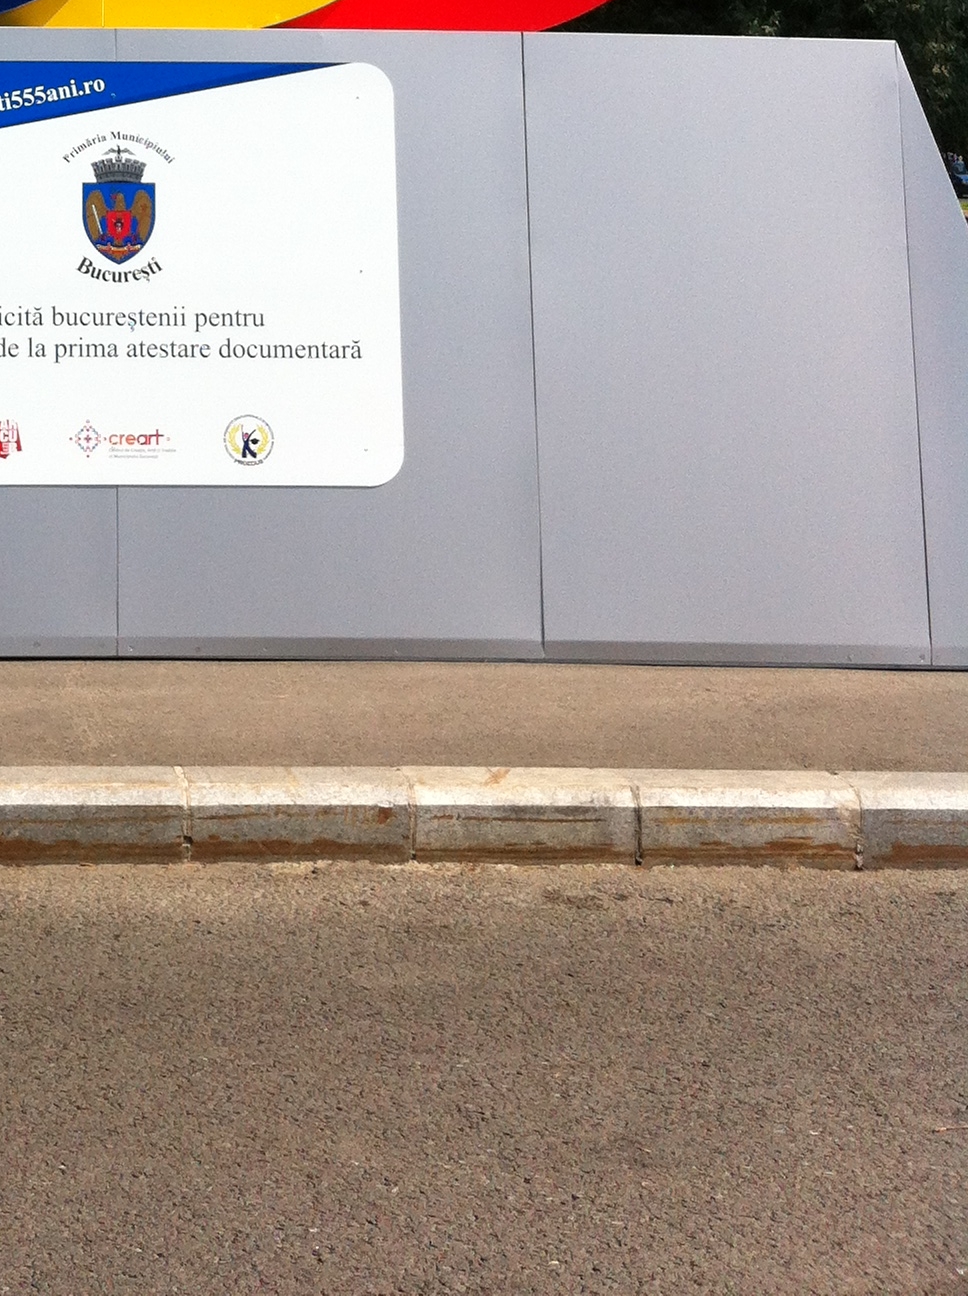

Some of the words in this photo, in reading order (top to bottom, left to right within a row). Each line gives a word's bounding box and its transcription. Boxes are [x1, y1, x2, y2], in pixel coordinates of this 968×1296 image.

[110, 131, 176, 164] Municipiului
[195, 308, 265, 333] pentru
[28, 337, 47, 358] la
[54, 337, 118, 364] prima
[126, 340, 211, 359] atestare
[219, 338, 362, 360] documentară
[108, 429, 164, 445] creart
